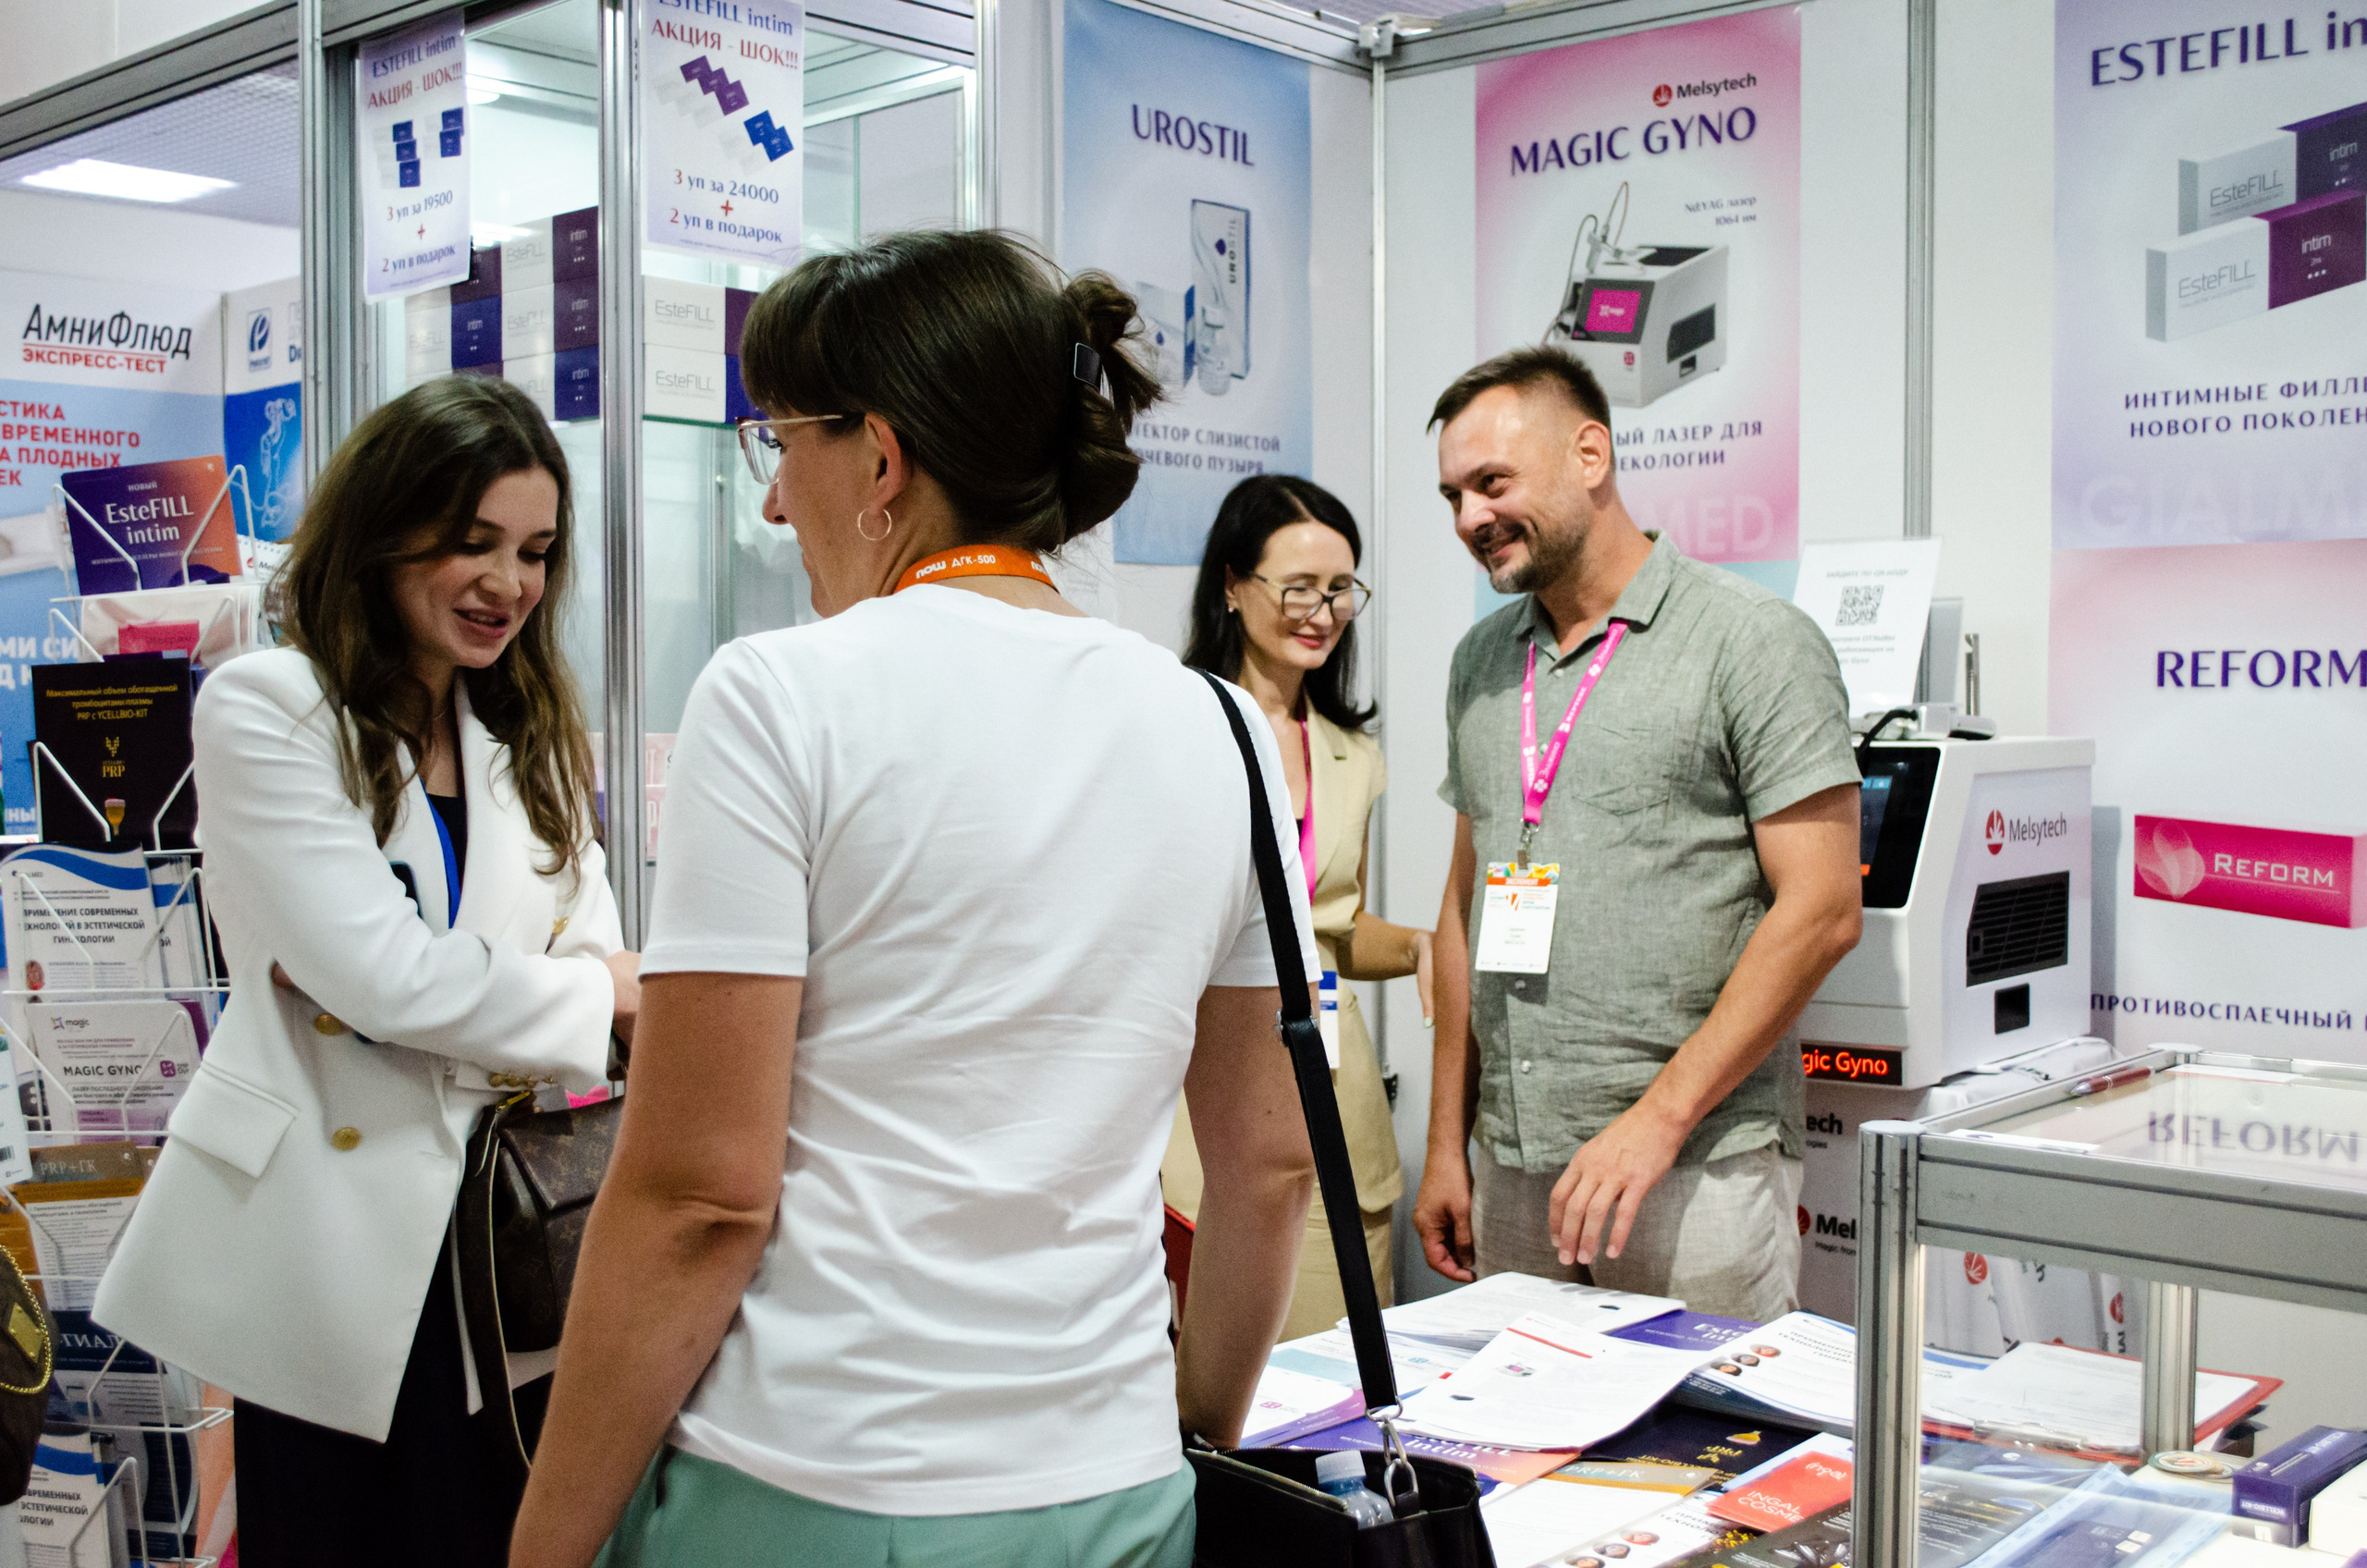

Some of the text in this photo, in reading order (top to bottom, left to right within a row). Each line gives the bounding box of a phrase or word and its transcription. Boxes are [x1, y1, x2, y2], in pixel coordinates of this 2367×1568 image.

[747, 7, 793, 36] intim
[373, 34, 456, 79] ESTEFILL intim
[651, 18, 722, 51] АКЦИЯ
[740, 39, 799, 70] ШОК!!!
[2091, 18, 2309, 86] ESTEFILL
[368, 80, 412, 109] АКЦИЯ
[423, 62, 463, 92] ШОК!!!
[1677, 73, 1757, 99] Melsytech
[1133, 104, 1255, 166] UROSTIL
[1511, 106, 1757, 176] MAGIC GYNO
[2329, 141, 2359, 162] intim
[673, 169, 779, 204] 3 уп за 24000
[2210, 170, 2284, 208] EsteFILL
[386, 190, 453, 221] 3 уп за 19500
[669, 208, 782, 244] 2 уп в подарок
[2301, 233, 2331, 255] intim
[382, 244, 456, 273] 2 уп в подарок
[2178, 260, 2255, 299] EsteFILL
[655, 299, 715, 324] EsteFILL
[23, 304, 192, 360] АмниФлюд
[23, 348, 167, 373] ЭКСПРЕСС-ТЕСТ
[656, 371, 715, 393] EsteFILL
[2125, 383, 2269, 410] ИНТИМНЫЕ
[2, 423, 141, 447] ВРЕМЕННОГО
[1196, 427, 1281, 452] СЛИЗИСТОЙ
[1653, 424, 1712, 444] ЛАЗЕР
[1720, 421, 1762, 441] ДЛЯ
[2130, 416, 2231, 439] НОВОГО
[18, 447, 121, 470] ПЛОДНЫХ
[1208, 455, 1264, 475] ПУЗЫРЯ
[1616, 450, 1725, 472] ЕКОЛОГИИ
[128, 481, 157, 492] НОВЫЙ
[105, 496, 194, 524] EsteFILL
[126, 524, 180, 545] intim
[915, 560, 946, 579] now
[2156, 649, 2367, 688] REFORM
[102, 764, 126, 778] PRP
[2008, 812, 2067, 846] Melsytech
[80, 908, 139, 916] СОВРЕМЕННЫХ
[84, 920, 145, 930] ЭСТЕТИЧЕСКОЙ
[65, 1018, 90, 1030] magic
[2091, 993, 2351, 1030] ПРОТИВОСПАЕЧНЫЙ
[63, 1065, 104, 1076] MAGIC
[1835, 1051, 1889, 1079] Gyno
[1404, 1439, 1478, 1459] intim
[20, 1501, 88, 1515] ЭСТЕТИЧЕСКОЙ
[1747, 1490, 1801, 1515] INGAL
